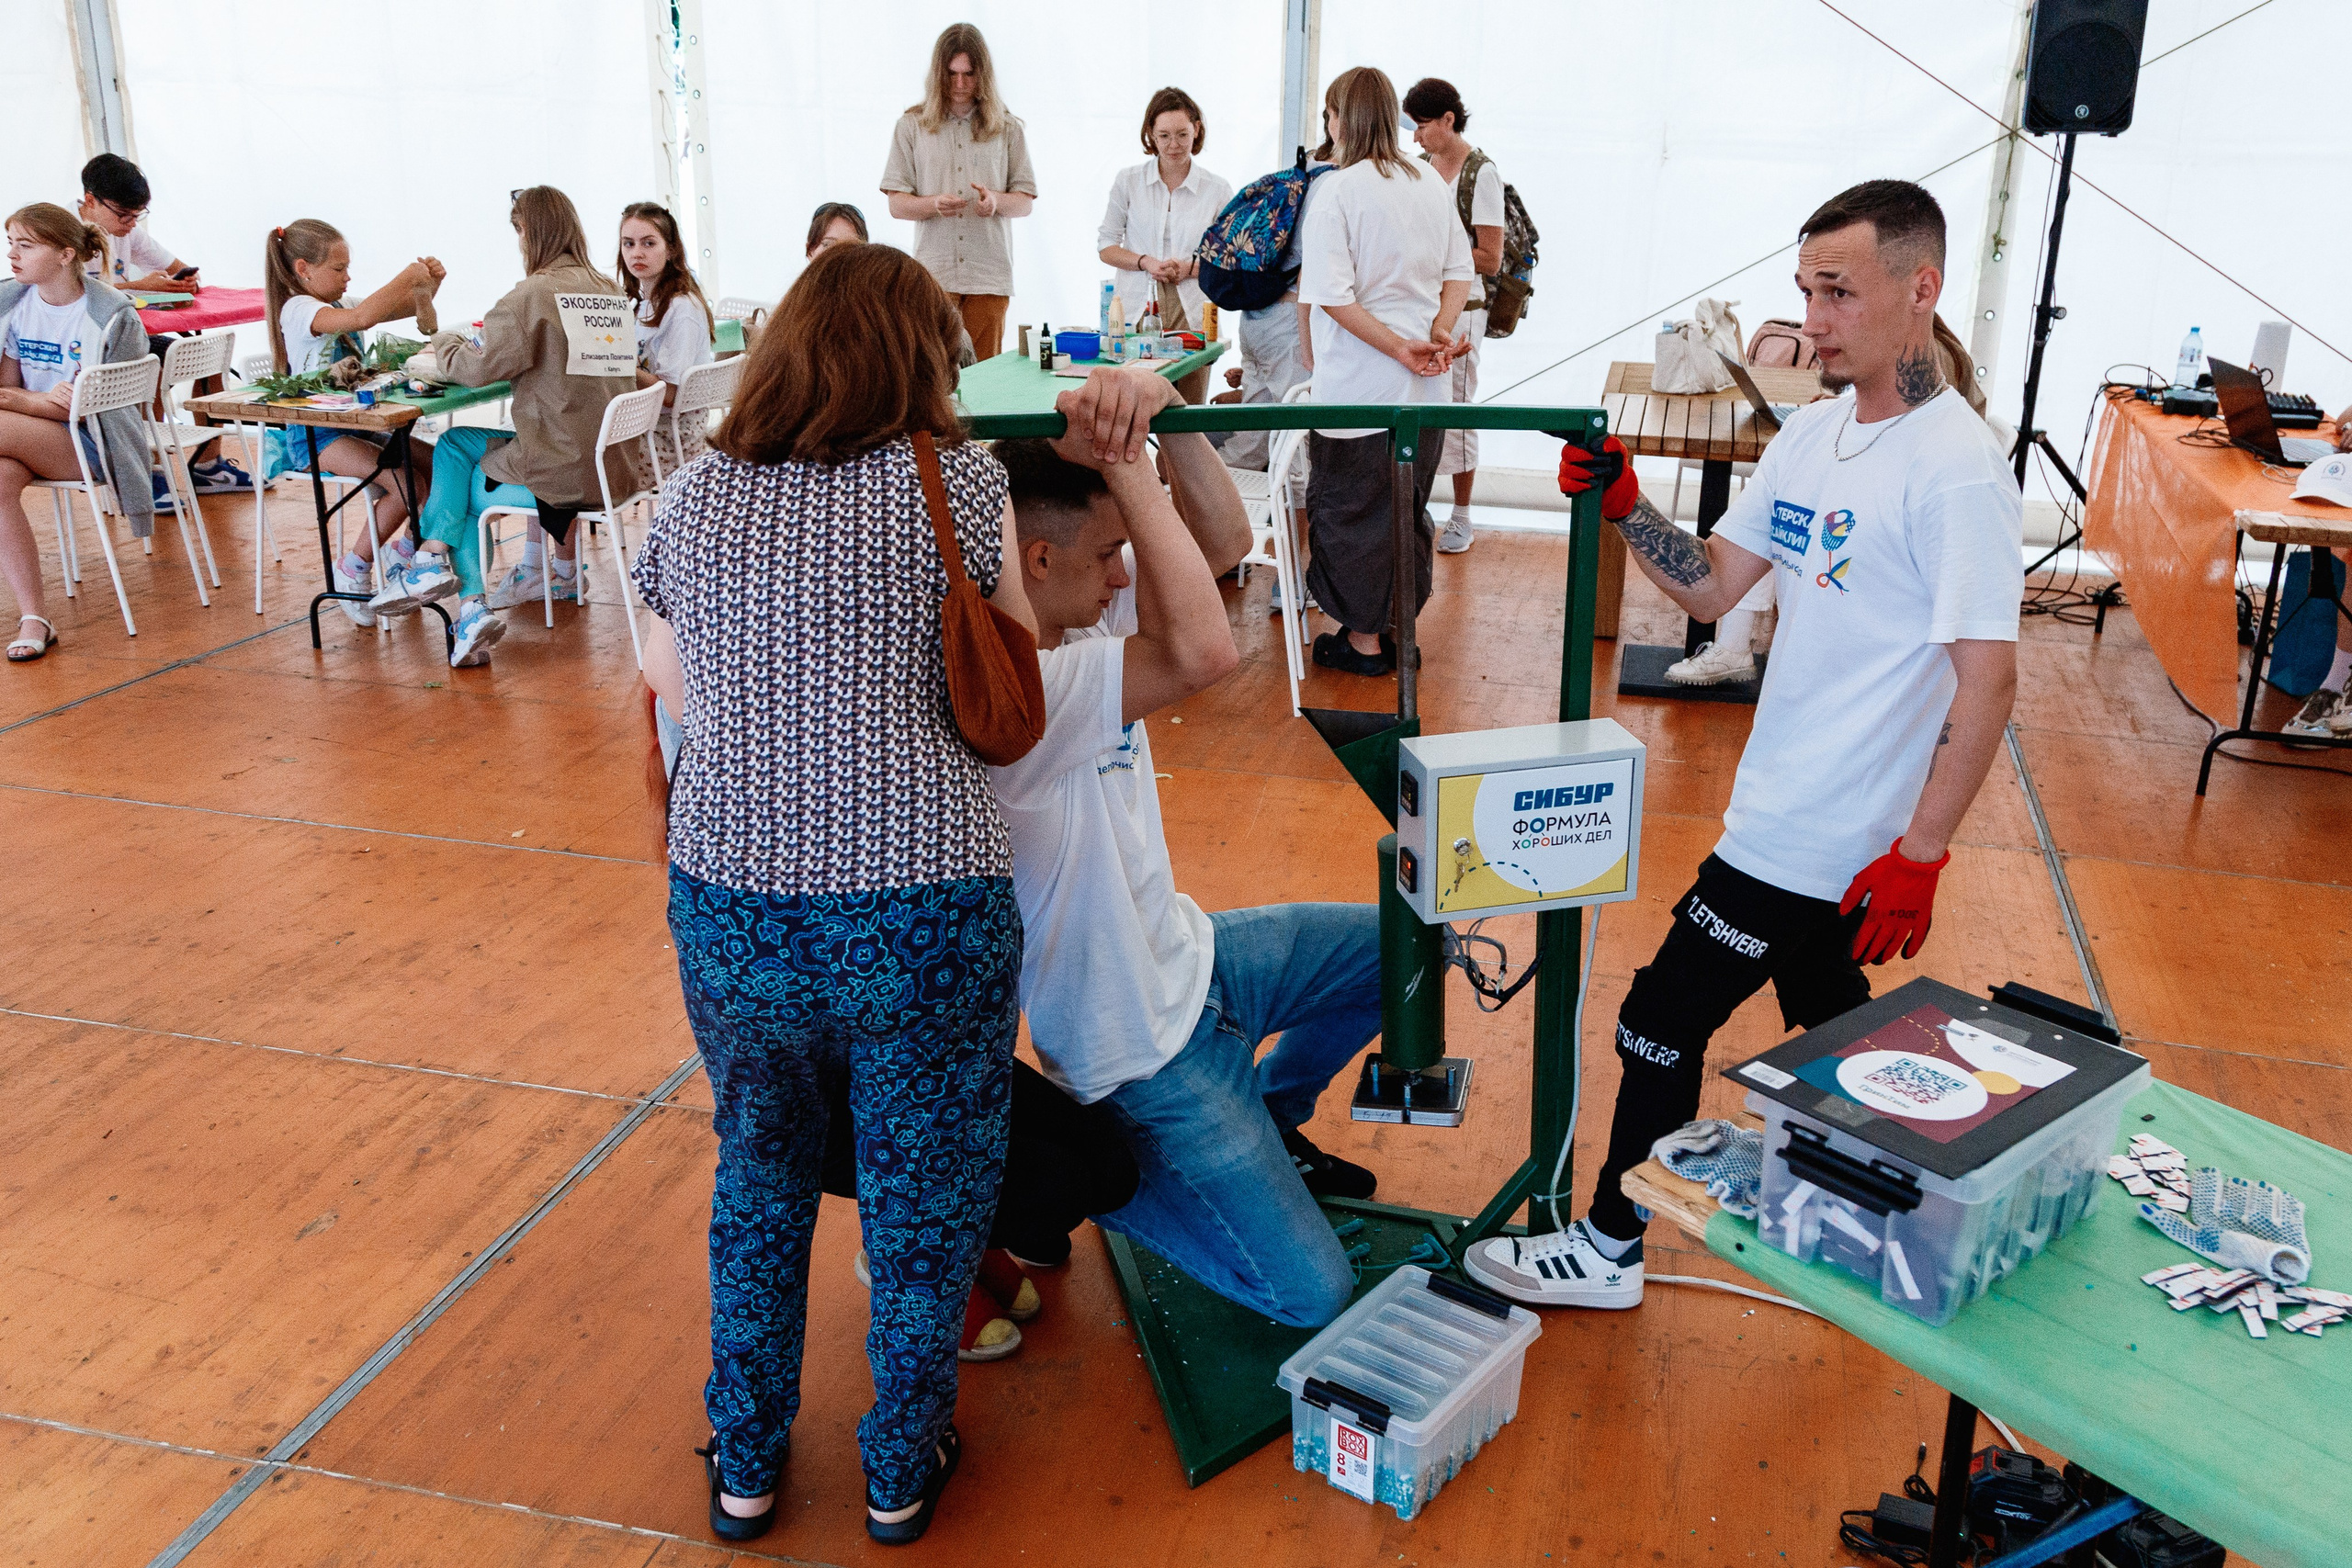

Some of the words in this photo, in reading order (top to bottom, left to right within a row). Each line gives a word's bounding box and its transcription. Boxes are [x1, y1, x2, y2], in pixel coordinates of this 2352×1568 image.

[560, 297, 628, 310] ЭКОСБОРНАЯ
[583, 315, 623, 328] РОССИИ
[18, 342, 59, 352] СТЕРСКАЯ
[1513, 782, 1614, 811] СИБУР
[1512, 811, 1611, 835] ФОРМУЛА
[1511, 833, 1582, 851] ХОРОШИХ
[1585, 829, 1611, 844] ДЕЛ
[1341, 1429, 1365, 1447] ROX
[1341, 1438, 1365, 1455] BOX
[1337, 1452, 1346, 1466] 8
